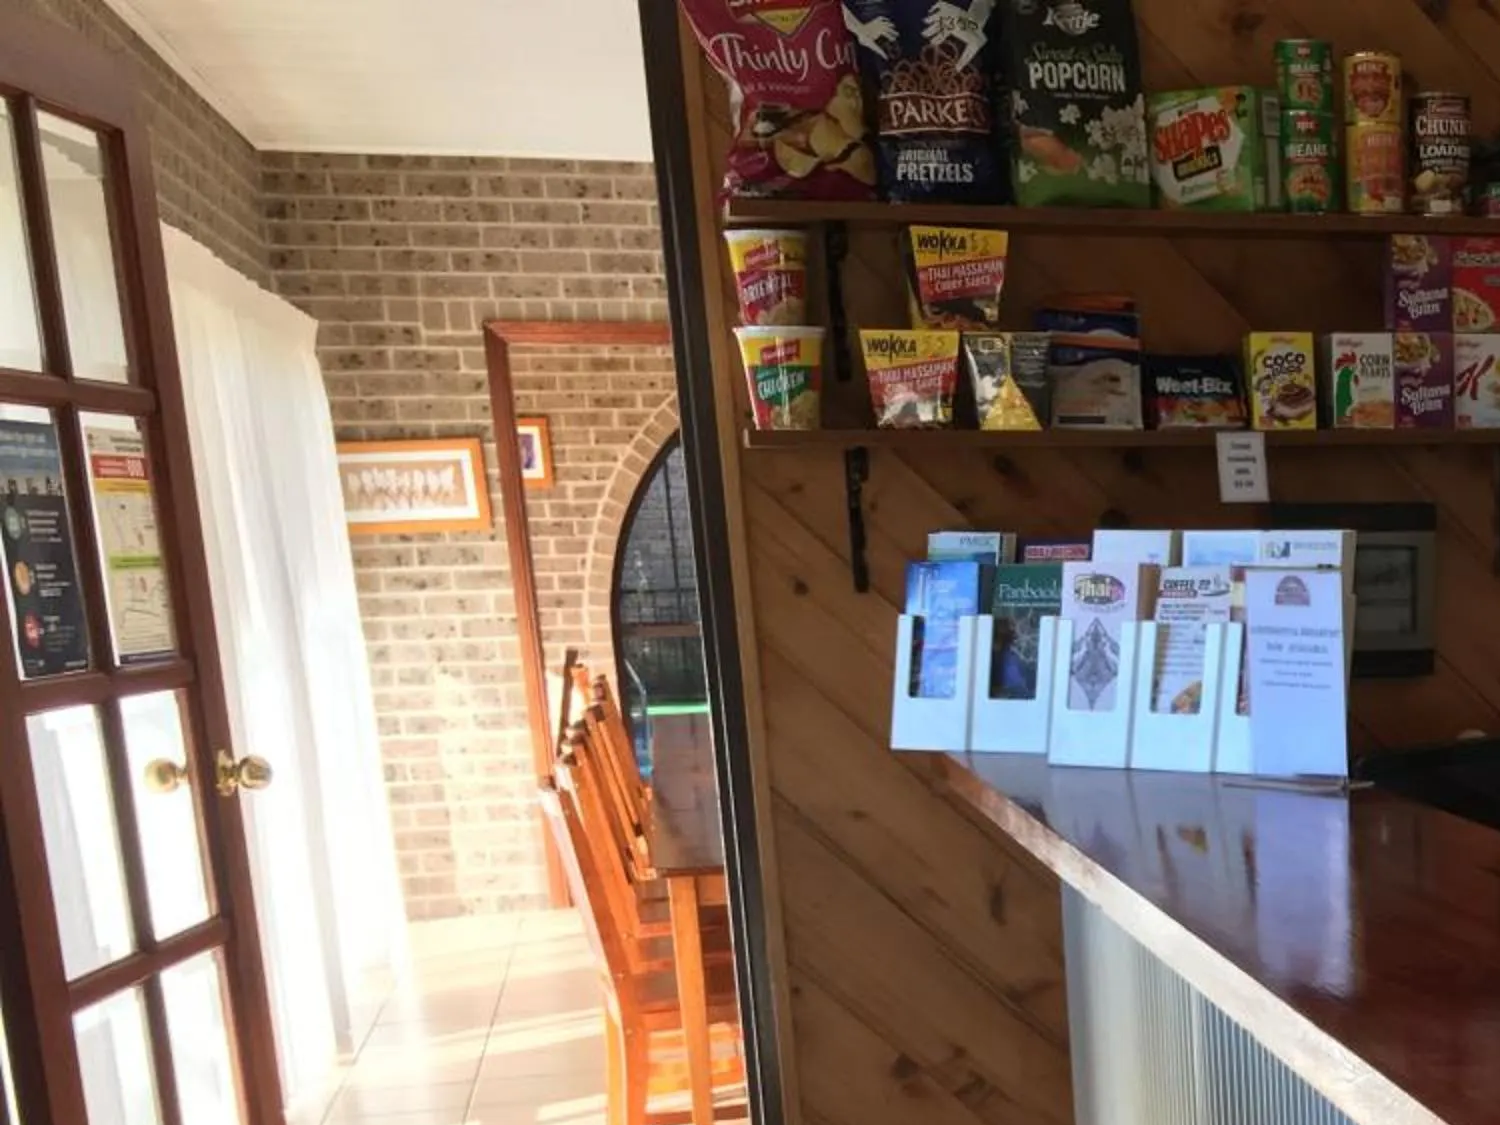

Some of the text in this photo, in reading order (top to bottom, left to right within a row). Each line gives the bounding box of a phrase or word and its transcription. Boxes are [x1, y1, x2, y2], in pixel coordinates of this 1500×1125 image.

[708, 31, 809, 82] Thinly
[1029, 61, 1126, 93] POPCORN
[896, 162, 975, 183] PRETZELS
[918, 231, 967, 259] WOKKA
[866, 333, 918, 363] WOKKA
[1263, 351, 1306, 369] COCO
[1155, 375, 1233, 395] Weet-Bix
